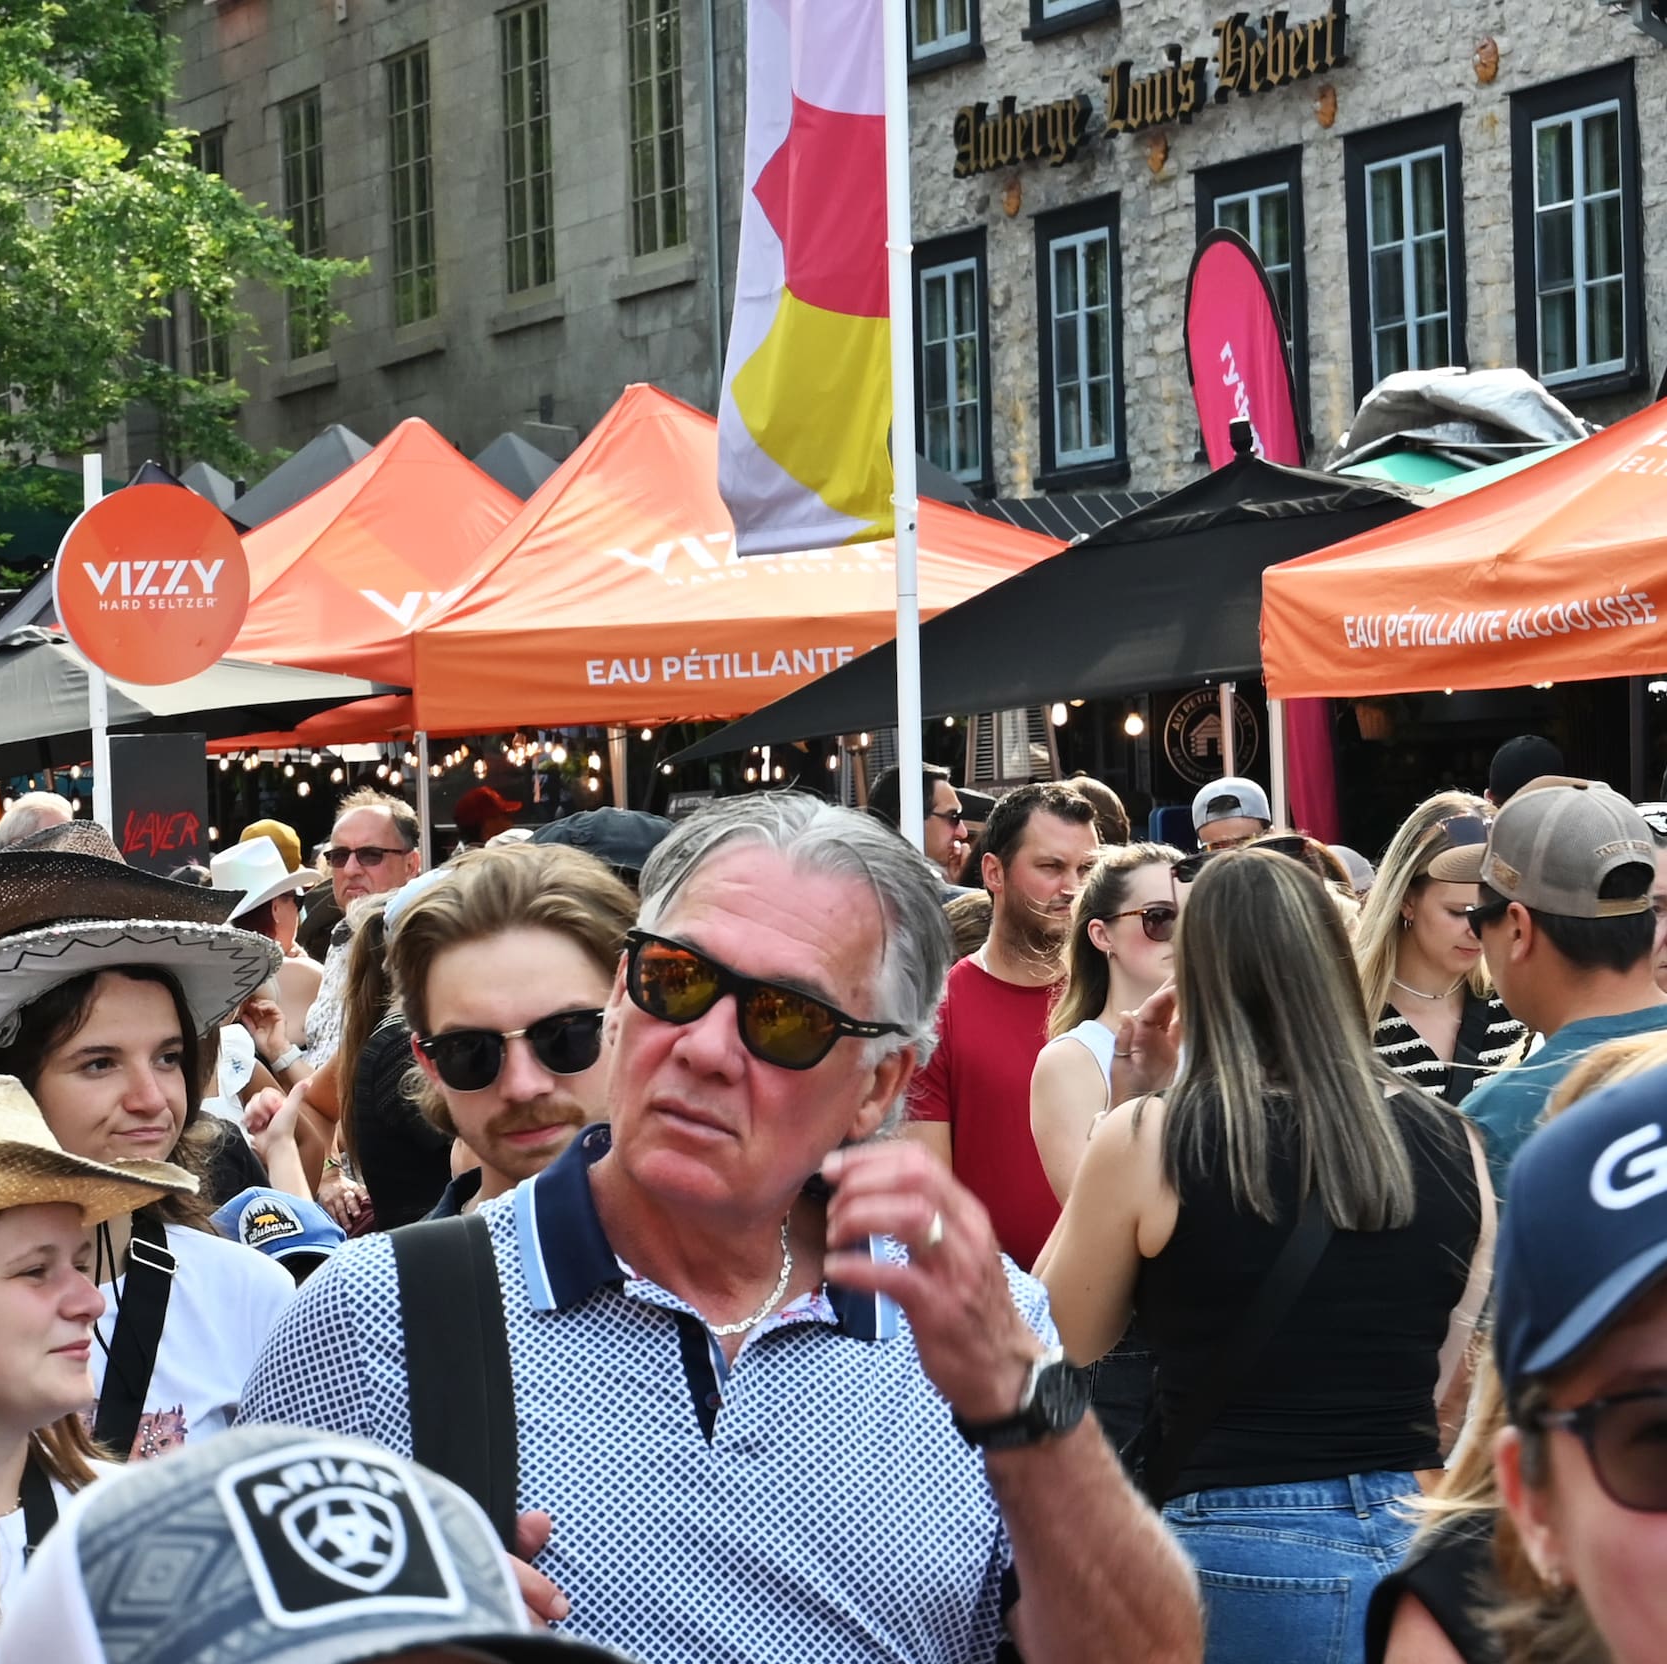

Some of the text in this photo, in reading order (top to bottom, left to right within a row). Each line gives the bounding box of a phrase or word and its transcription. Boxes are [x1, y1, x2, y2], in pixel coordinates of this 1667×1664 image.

[954, 98, 1087, 177] Auberge
[1102, 58, 1202, 137] Louis
[82, 559, 224, 596] VIZZY
[99, 597, 215, 611] HARD SELTZER
[1343, 583, 1658, 648] EAU PÉTILLANTE ALCOOLISÉE
[586, 646, 854, 686] EAU PÉTILLANTE
[1171, 712, 1184, 731] AU
[1183, 692, 1212, 713] PETIT
[123, 809, 200, 858] SLAYER
[248, 1219, 294, 1242] Subaru
[253, 1458, 402, 1516] ARIAT
